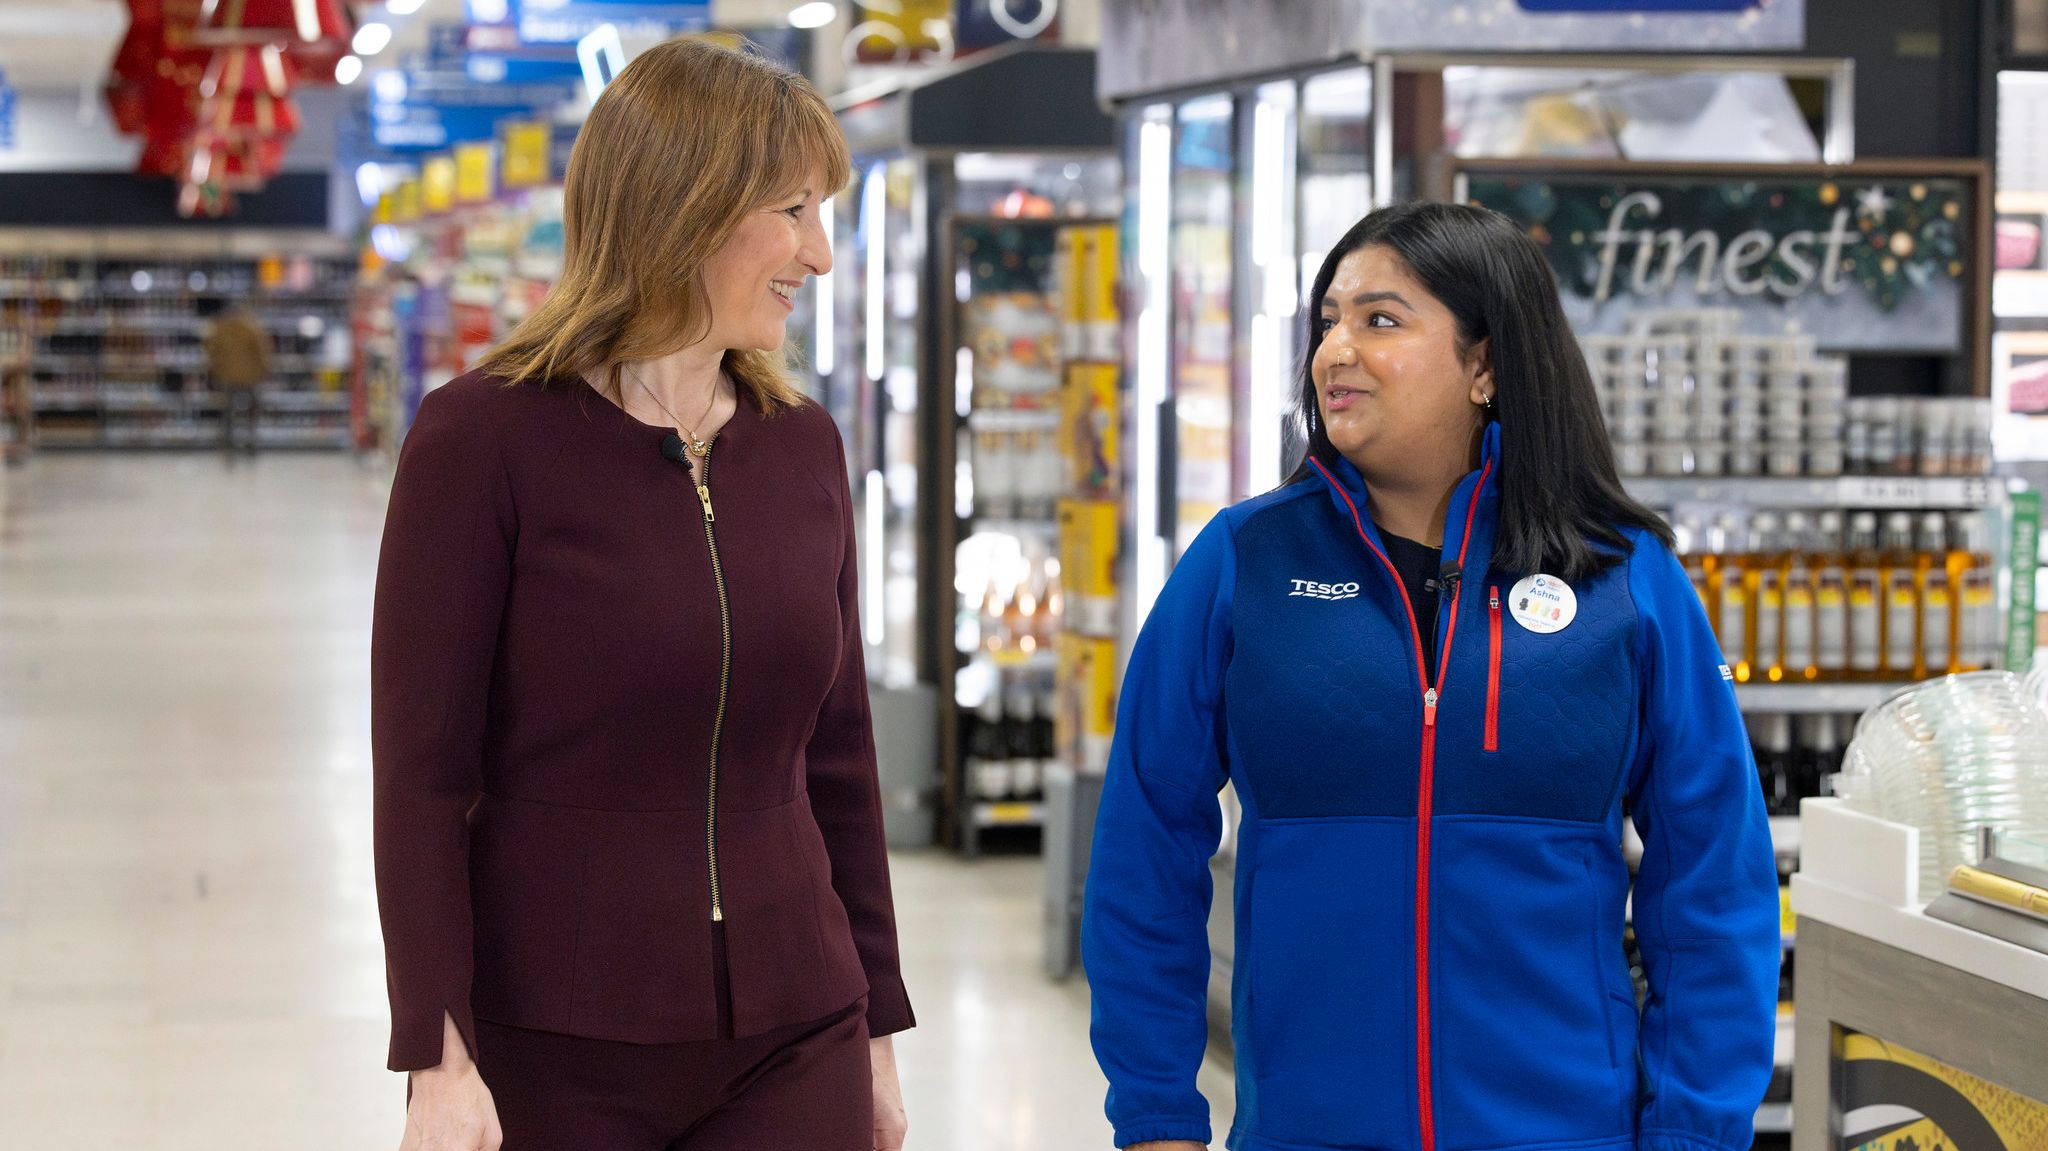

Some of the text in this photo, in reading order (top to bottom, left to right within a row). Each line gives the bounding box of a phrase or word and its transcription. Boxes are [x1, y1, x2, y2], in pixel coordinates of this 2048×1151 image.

[1594, 190, 1861, 303] finest
[1290, 578, 1360, 596] TESCO
[1529, 587, 1560, 602] Ashna
